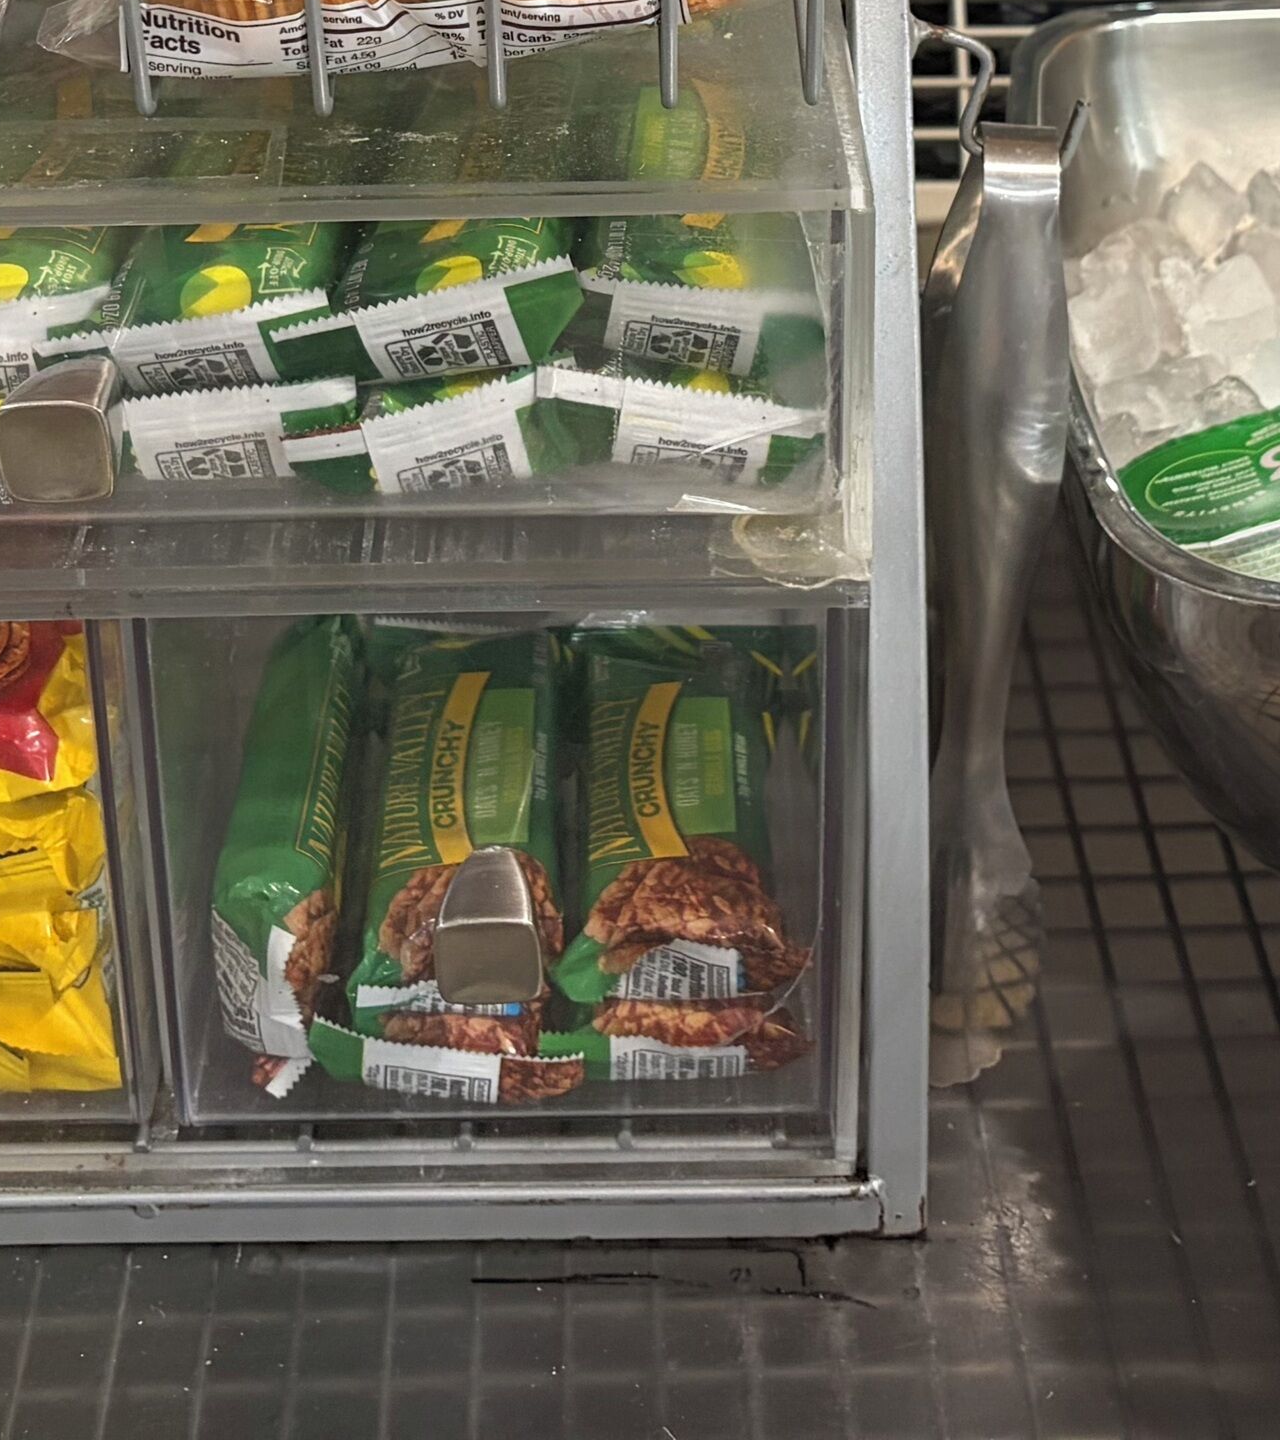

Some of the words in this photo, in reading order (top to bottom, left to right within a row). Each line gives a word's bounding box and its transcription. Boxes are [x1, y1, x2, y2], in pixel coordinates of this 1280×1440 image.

[141, 10, 241, 44] Nutrition
[448, 10, 465, 21] DV
[357, 34, 382, 47] 22g
[520, 30, 556, 43] Carb.
[149, 60, 203, 76] serving
[326, 54, 347, 66] Fat
[350, 50, 377, 63] 4.5g
[402, 310, 492, 338] how2recycle.info
[154, 341, 246, 361] how2recycle.info
[174, 430, 266, 449] how2recycle.info
[433, 719, 465, 830] CRUNCHY
[631, 721, 662, 819] CRUNCHY
[475, 782, 499, 819] OATS
[675, 777, 700, 808] OATS
[380, 779, 432, 869] NATURE
[588, 777, 642, 861] NATURE
